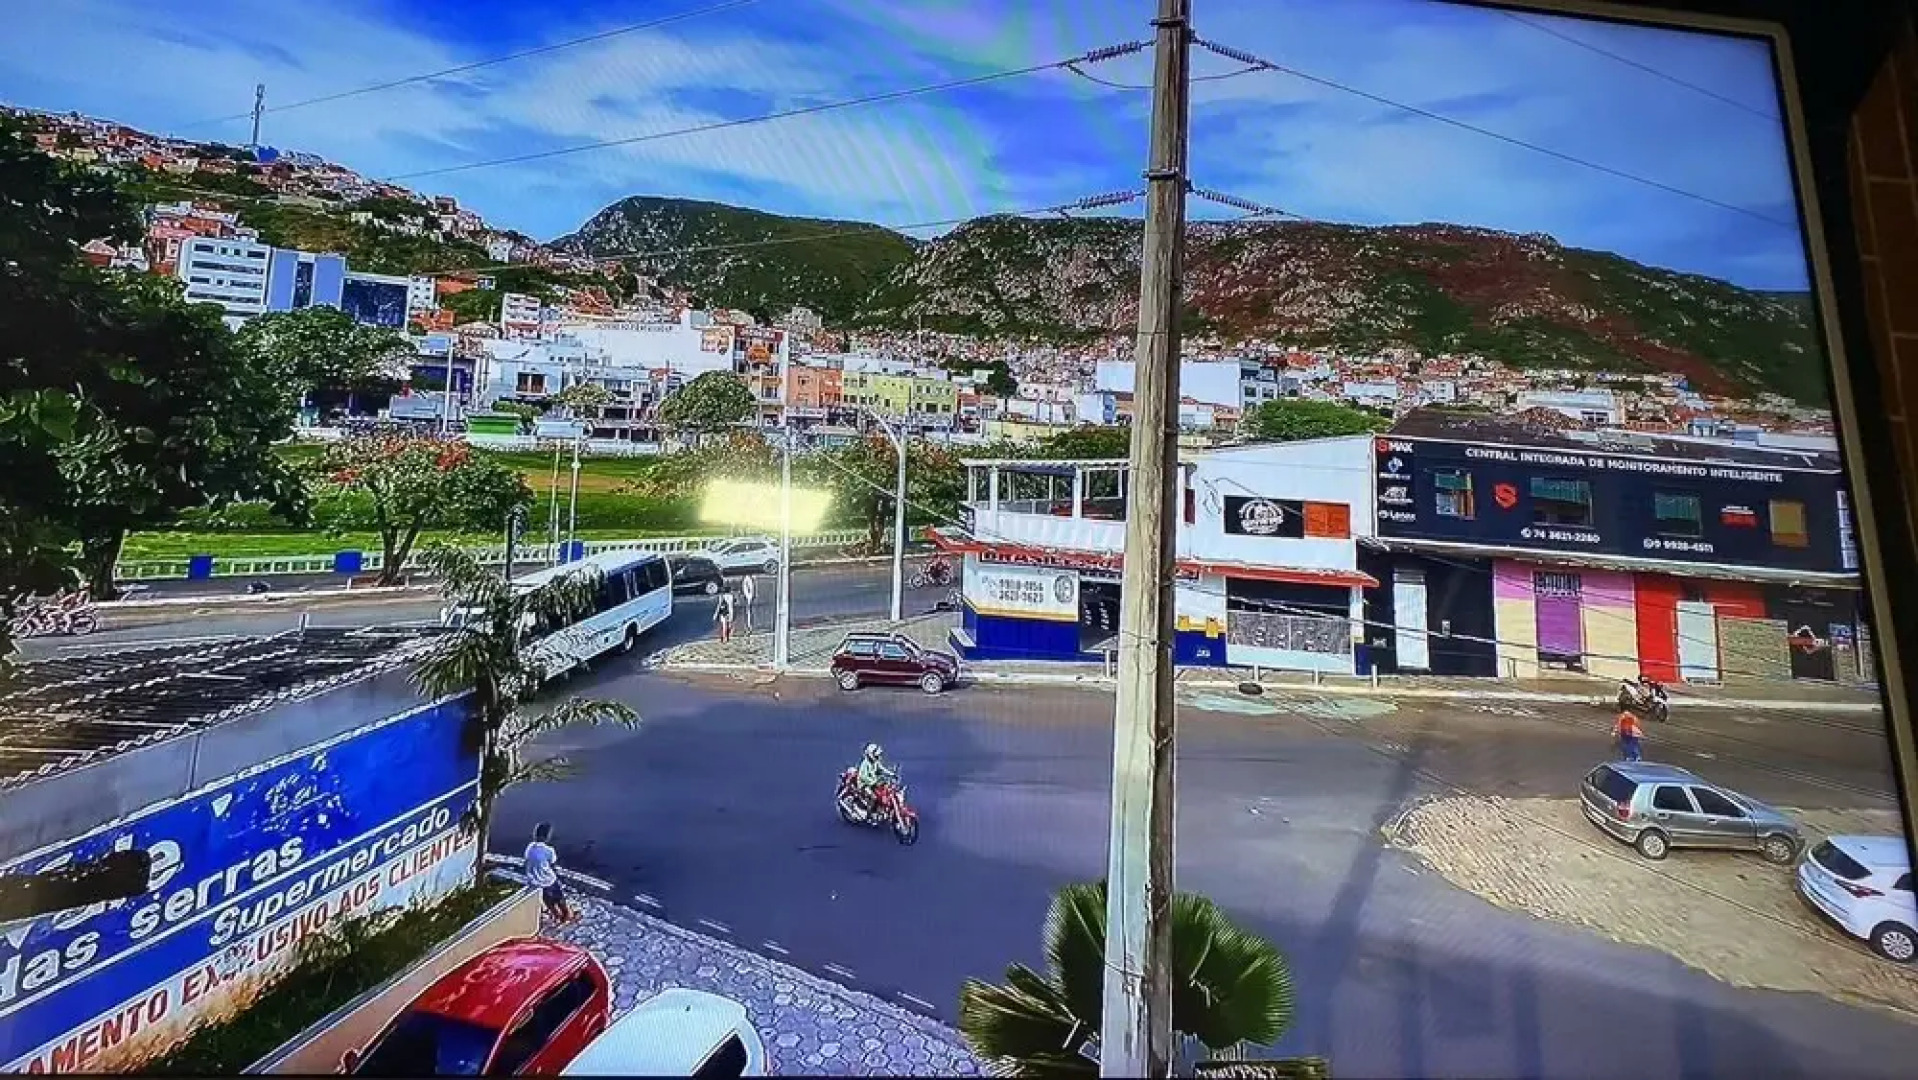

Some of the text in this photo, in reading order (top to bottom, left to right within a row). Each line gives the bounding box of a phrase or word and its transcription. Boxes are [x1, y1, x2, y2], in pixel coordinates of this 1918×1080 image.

[1465, 448, 1784, 482] CENTRAL INTEGRADA DE MONITORAMENTO INTELIGENTE
[130, 836, 303, 939] serras
[209, 807, 450, 945] Supermercado
[340, 873, 381, 913] AOS
